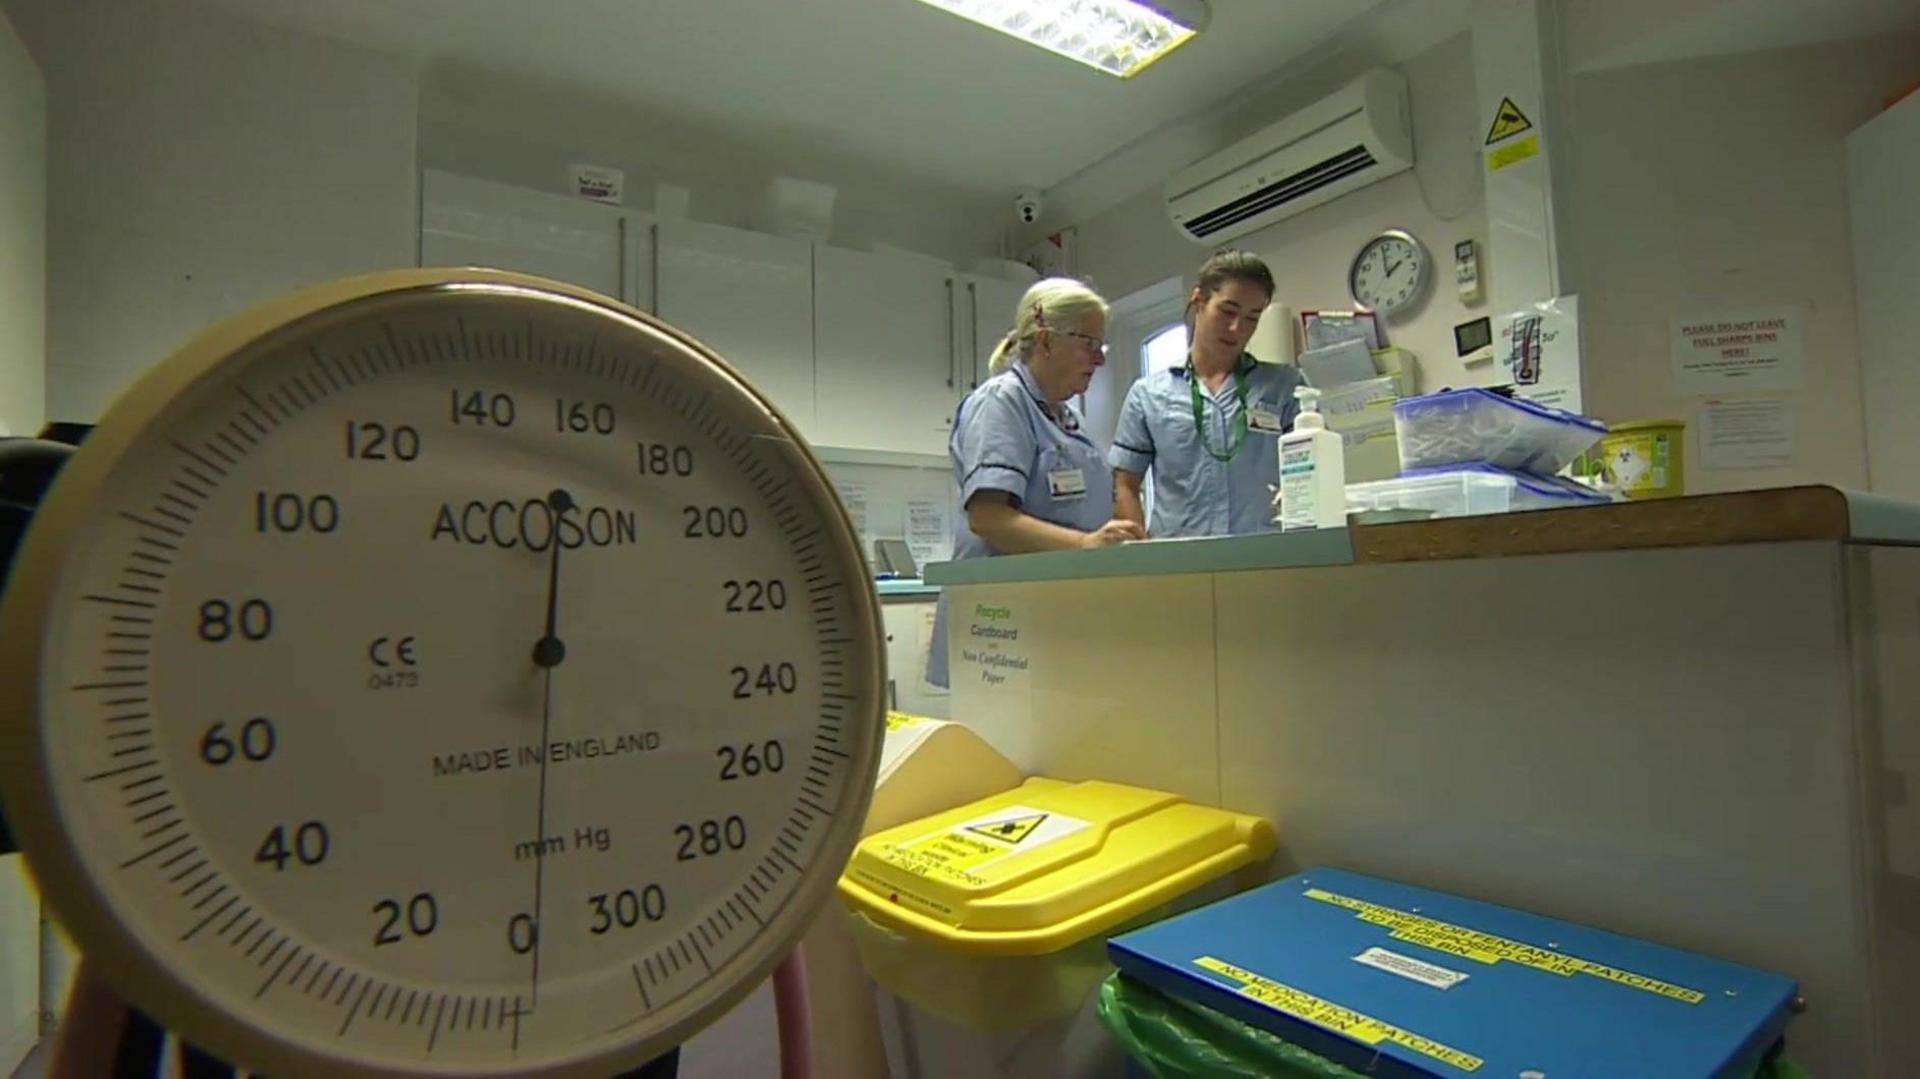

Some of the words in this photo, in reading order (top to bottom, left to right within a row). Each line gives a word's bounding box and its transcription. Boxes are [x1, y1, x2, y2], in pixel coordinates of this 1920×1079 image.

[452, 389, 514, 428] 140
[557, 399, 615, 436] 160
[346, 421, 420, 463] 120
[638, 442, 693, 477] 180
[256, 491, 339, 535] 100
[431, 498, 636, 552] ACCOSON
[683, 506, 748, 539] 200
[723, 580, 787, 613] 220
[975, 603, 1011, 621] Recycle
[198, 598, 272, 643] 80
[970, 623, 1018, 641] Cardboard
[731, 661, 797, 700] 240
[979, 651, 1029, 670] Confidential
[200, 717, 276, 767] 60
[432, 748, 511, 776] MADE
[517, 745, 543, 767] IN
[550, 732, 660, 763] ENGLAND
[717, 739, 784, 781] 260
[255, 821, 330, 872] 40
[514, 835, 566, 861] mm
[574, 825, 611, 852] Hg
[674, 814, 747, 863] 280
[373, 892, 438, 947] 20
[588, 883, 667, 936] 300
[508, 912, 537, 955] 0
[1354, 900, 1440, 928] SYRINGES
[1440, 924, 1468, 937] OR
[1471, 931, 1577, 966] FENTANYL
[1581, 962, 1699, 1001] PATCHES
[1363, 913, 1386, 923] TO
[1415, 926, 1512, 957] DISPOSED
[1515, 954, 1548, 966] OF
[1551, 962, 1575, 975] IN
[1393, 929, 1436, 946] THIS
[1437, 941, 1471, 956] BIN
[1218, 965, 1248, 979] NO
[1248, 976, 1364, 1025] MEDICATION
[1367, 1021, 1480, 1070] PATCHES
[1247, 986, 1269, 999] IN
[1269, 994, 1313, 1018] THIS
[1314, 1012, 1351, 1031] BIN
